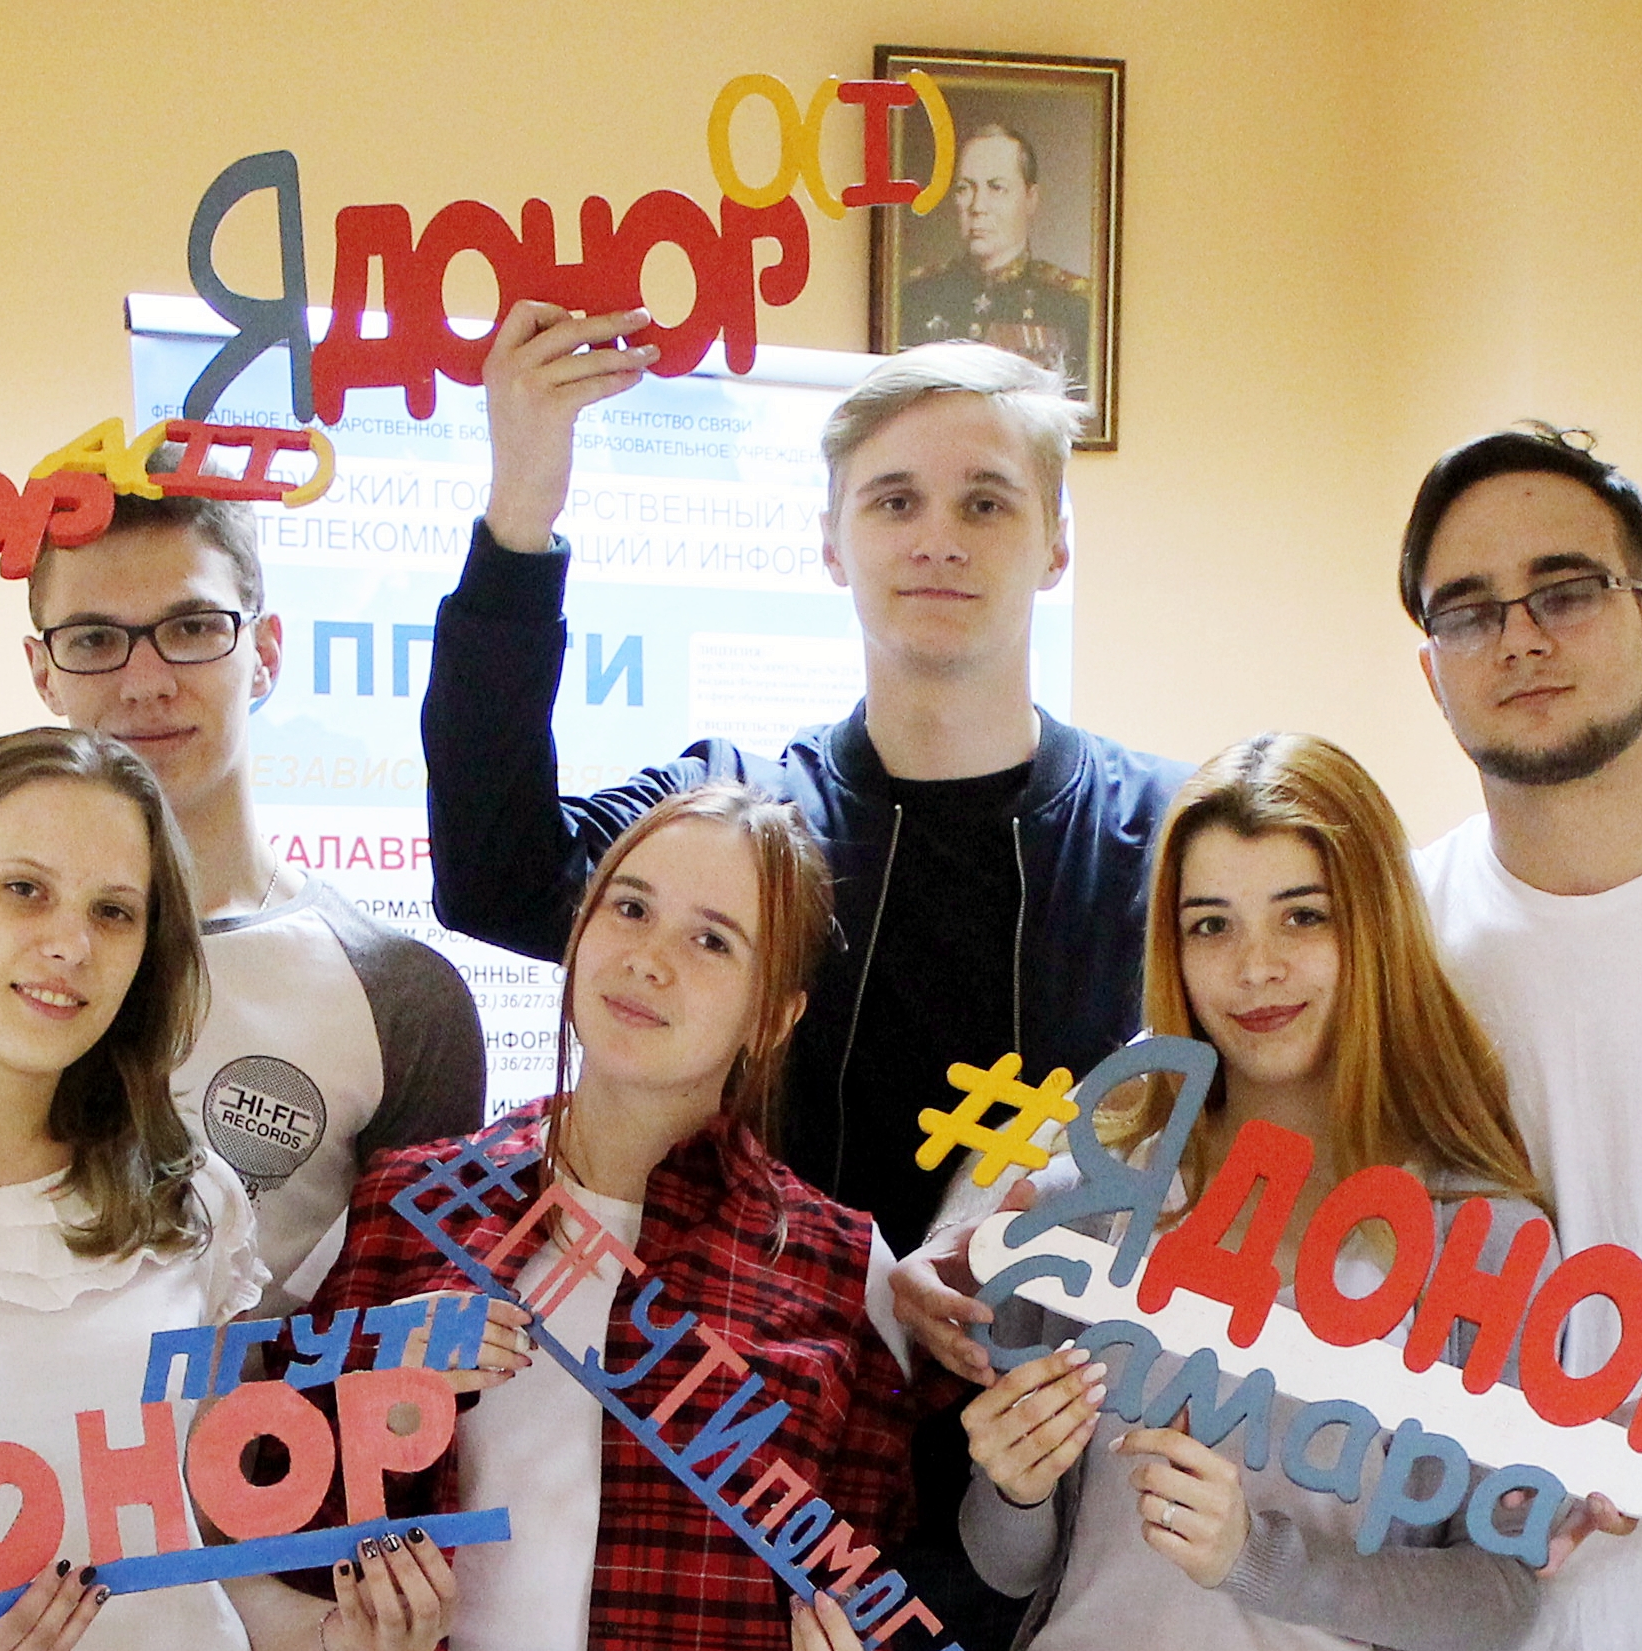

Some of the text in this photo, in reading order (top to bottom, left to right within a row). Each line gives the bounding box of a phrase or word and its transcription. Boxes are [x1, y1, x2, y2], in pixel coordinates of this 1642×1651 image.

[601, 409, 694, 431] АГЕНТСТВО
[698, 415, 752, 434] СВЯЗИ
[572, 433, 730, 458] ОБРАЗОВАТЕЛЬНОЕ
[222, 1110, 302, 1151] RECORDS
[142, 1293, 490, 1404] ПГУТИ
